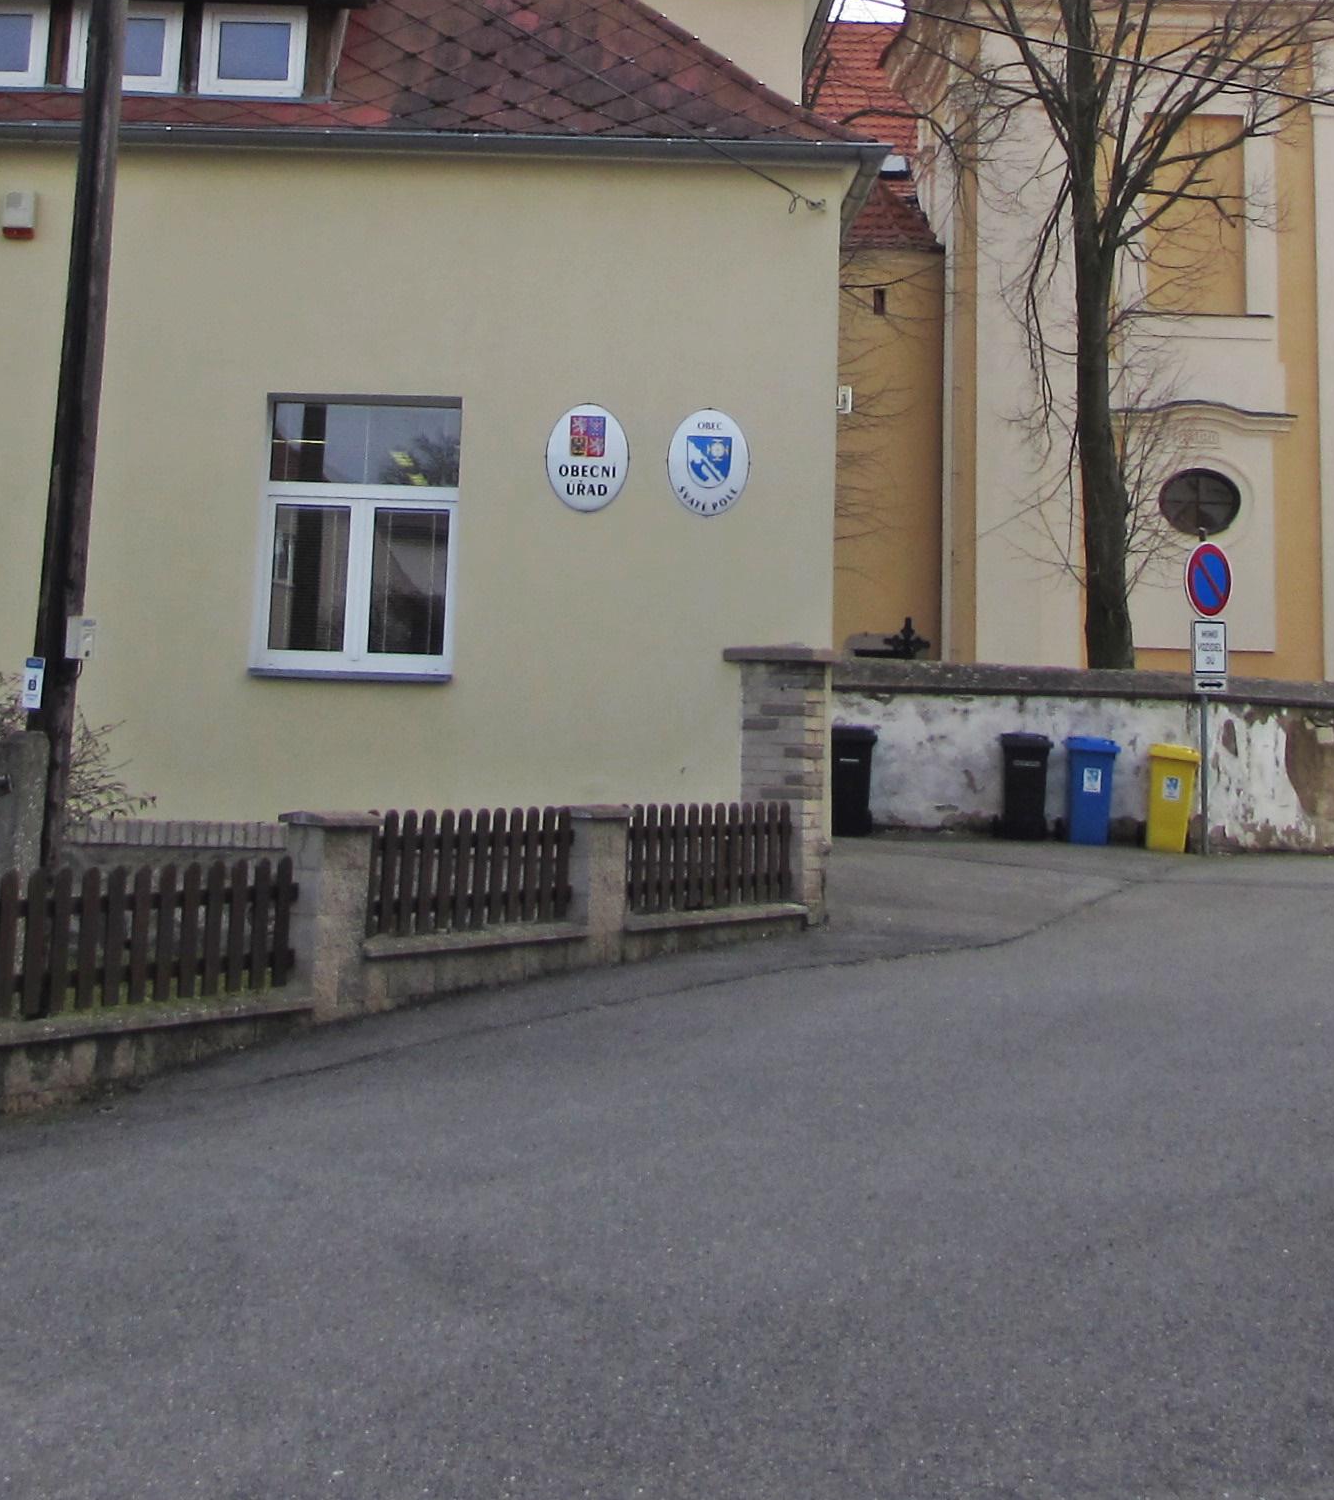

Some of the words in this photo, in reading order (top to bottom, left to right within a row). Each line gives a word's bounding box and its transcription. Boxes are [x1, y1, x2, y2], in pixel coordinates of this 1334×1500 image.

[697, 421, 723, 431] OBEC
[558, 462, 617, 479] OBECNÍ
[566, 479, 608, 497] ÚŘAD
